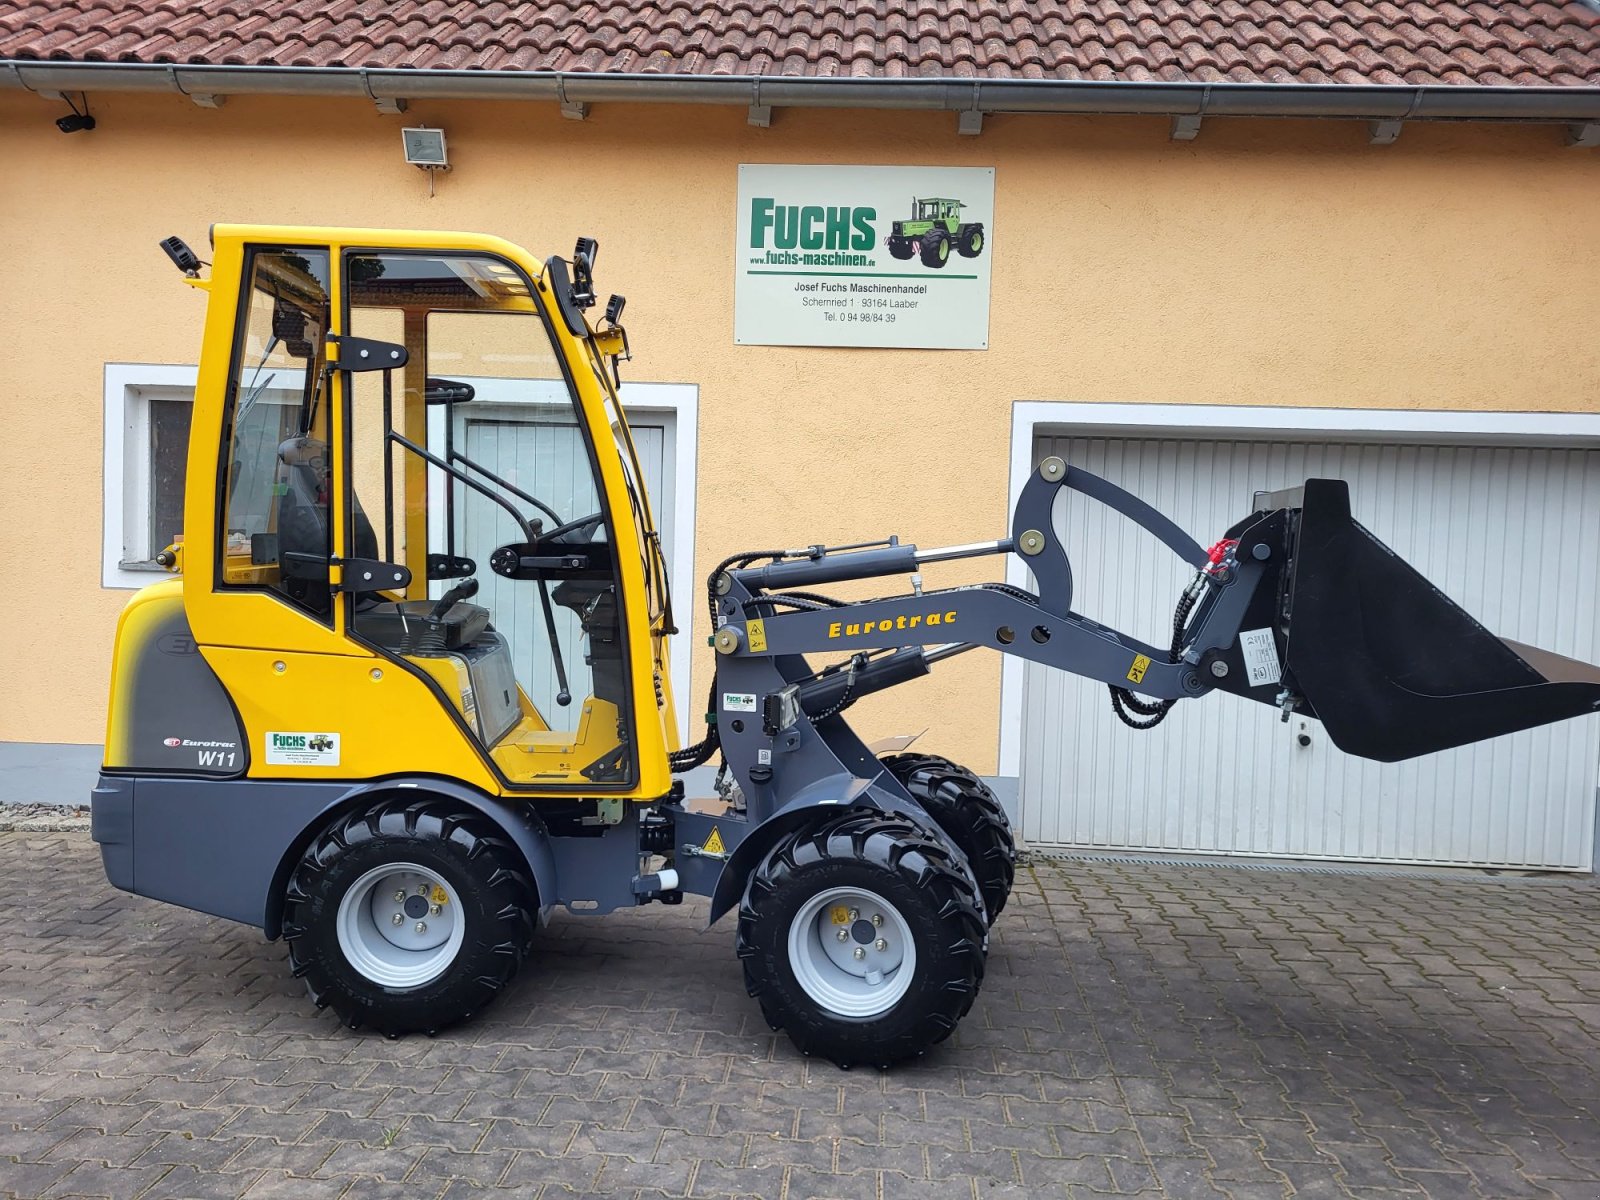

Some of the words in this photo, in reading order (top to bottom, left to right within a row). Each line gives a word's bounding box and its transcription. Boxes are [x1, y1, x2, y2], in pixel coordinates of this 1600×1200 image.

[750, 198, 876, 251] FUCHS
[750, 250, 876, 267] www.fuchs-maschinen.de
[794, 282, 819, 292] Josef
[821, 282, 848, 292] Fuchs
[850, 283, 928, 294] Maschinenhandel
[802, 296, 847, 307] Schernried
[861, 298, 888, 308] 93164
[889, 299, 919, 309] Laaber
[824, 311, 838, 321] Tel.
[840, 313, 846, 321] 0
[847, 313, 858, 322] 94
[860, 313, 883, 323] 98/84
[885, 313, 896, 323] 39
[828, 611, 957, 638] Eurotrac
[181, 739, 236, 748] Eurotrac
[273, 733, 306, 747] FUCHS
[198, 750, 236, 767] W11
